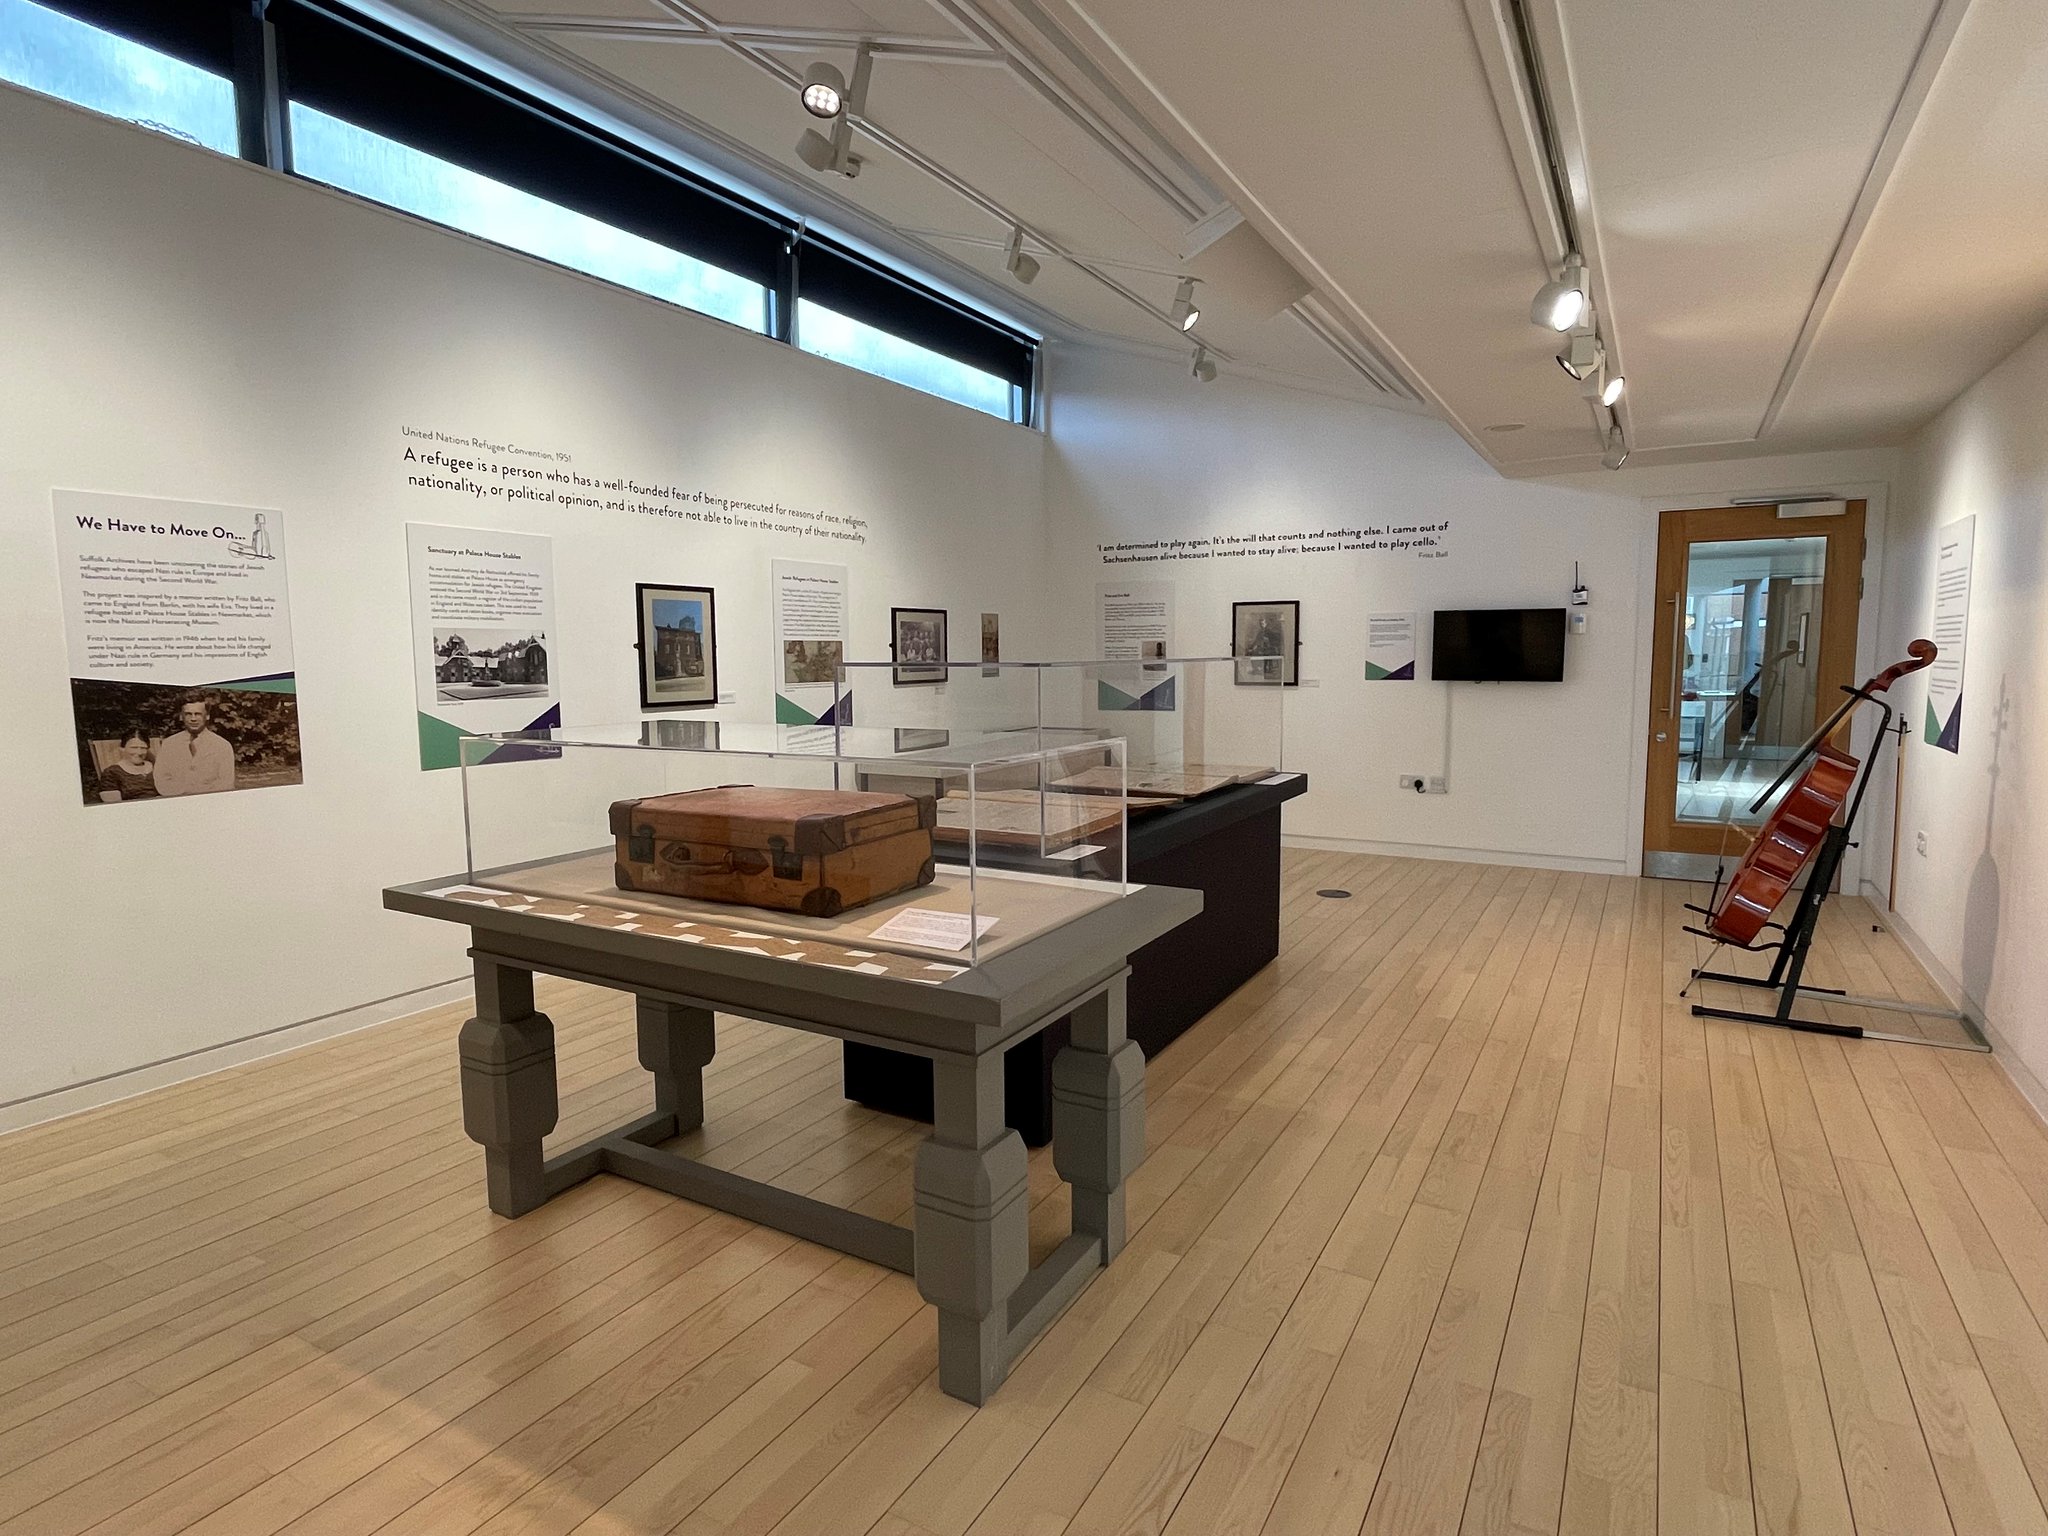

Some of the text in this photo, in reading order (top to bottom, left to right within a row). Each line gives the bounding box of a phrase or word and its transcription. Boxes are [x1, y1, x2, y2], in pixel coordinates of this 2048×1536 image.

[402, 425, 572, 463] United Nations Refugee Convention, 1951
[404, 447, 416, 462] A
[421, 451, 474, 474] refugee
[478, 457, 487, 472] is
[492, 464, 498, 473] a
[502, 466, 543, 480] person
[546, 469, 570, 483] who
[573, 471, 591, 487] has
[595, 480, 600, 488] a
[603, 479, 669, 498] well-founded
[672, 487, 690, 500] fear
[693, 492, 702, 502] of
[705, 493, 728, 511] being
[731, 500, 773, 514] persecuted
[776, 504, 787, 516] for
[789, 509, 815, 520] reasons
[816, 511, 824, 520] of
[843, 515, 868, 529] religion,
[409, 473, 487, 499] nationality,
[491, 487, 503, 496] or
[508, 485, 555, 502] political
[558, 492, 603, 511] opinion,
[606, 499, 625, 511] and
[628, 500, 635, 513] is
[638, 502, 683, 519] therefore
[686, 512, 701, 521] not
[703, 511, 721, 523] able
[723, 516, 732, 525] to
[734, 515, 748, 527] live
[750, 516, 758, 529] in
[760, 519, 772, 530] the
[775, 523, 803, 538] country
[805, 525, 813, 535] of
[814, 527, 830, 538] their
[76, 515, 246, 540] We Have to Move On...
[1116, 540, 1158, 551] determined
[1170, 539, 1186, 550] play
[1213, 536, 1225, 545] It's
[1227, 536, 1240, 544] the
[1243, 534, 1256, 543] will
[1259, 534, 1276, 542] that
[1278, 533, 1306, 541] counts
[1309, 530, 1324, 539] and
[1327, 527, 1361, 539] nothing
[1364, 526, 1384, 536] else.
[1387, 525, 1389, 534] I
[1392, 526, 1417, 534] came
[1420, 524, 1436, 532] out
[1438, 521, 1449, 531] of
[428, 546, 457, 556] Sanctuary
[466, 549, 483, 557] Palace
[502, 552, 521, 560] Stables
[1103, 554, 1158, 564] Sachsenhausen
[1160, 552, 1177, 560] alive
[1179, 551, 1209, 559] because
[1212, 550, 1215, 558] I
[1217, 548, 1246, 557] wanted
[1259, 548, 1275, 558] stay
[1302, 544, 1335, 553] because
[1338, 543, 1341, 551] I
[1344, 540, 1376, 550] wanted
[1379, 541, 1388, 549] to
[1391, 539, 1410, 551] play
